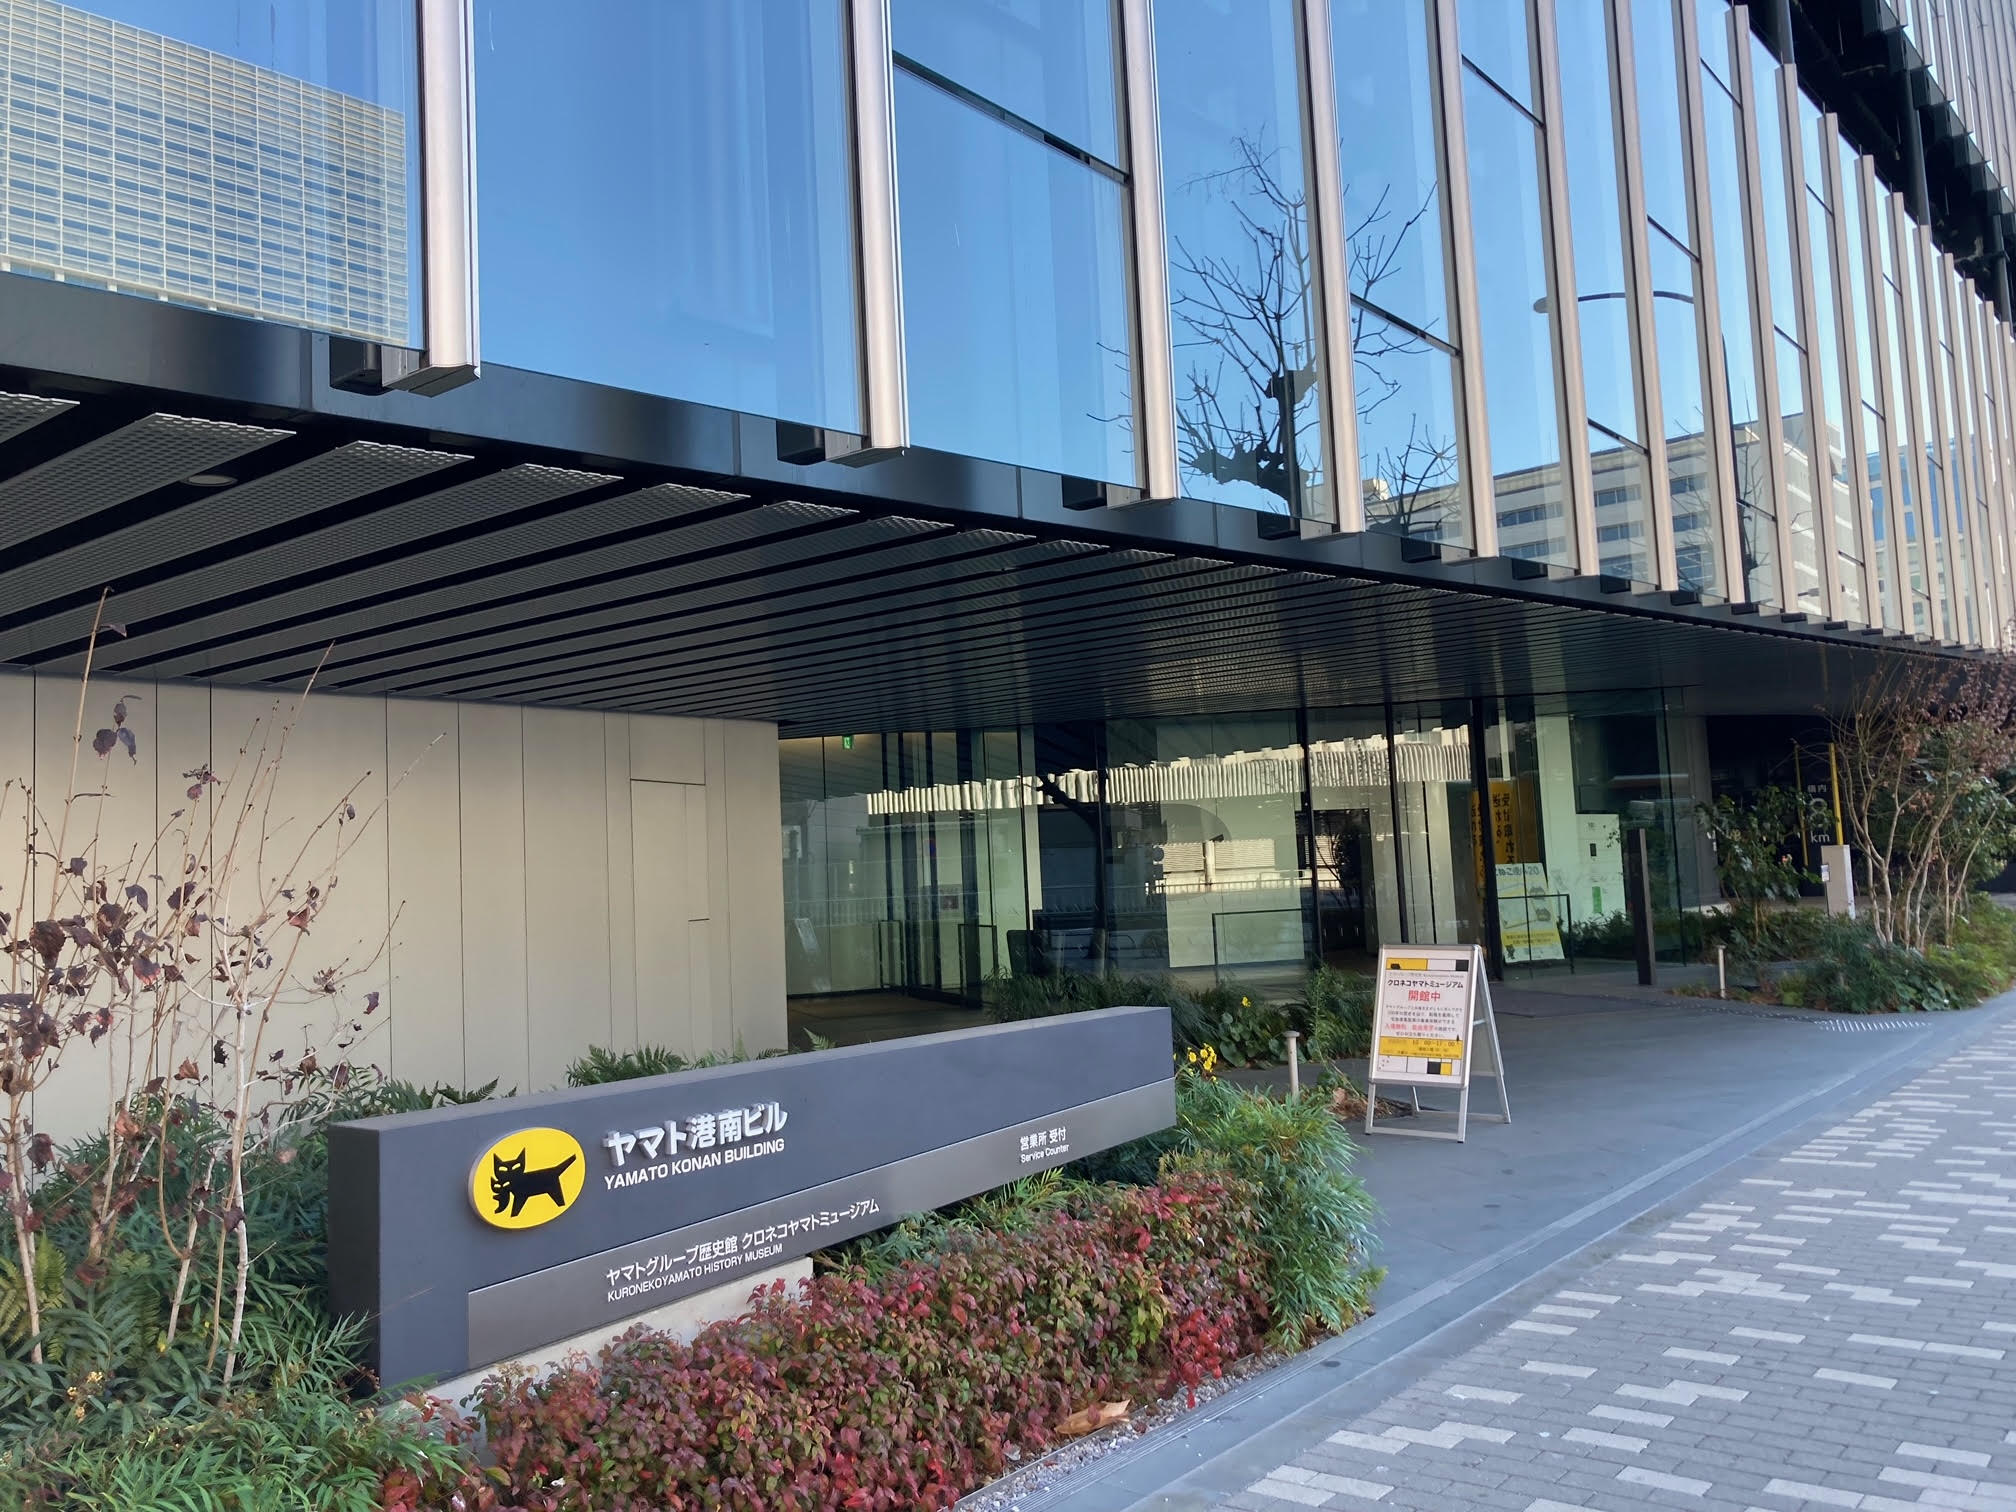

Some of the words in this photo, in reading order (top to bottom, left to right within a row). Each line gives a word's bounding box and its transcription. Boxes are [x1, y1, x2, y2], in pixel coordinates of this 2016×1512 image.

[1810, 830, 1830, 844] km
[1387, 979, 1463, 989] クロネコヤマトミュージアム
[1408, 990, 1440, 1002] 開館中
[604, 1102, 788, 1166] ヤマト港南ビル
[1020, 1131, 1047, 1151] 営業所
[1049, 1126, 1066, 1143] 受付
[604, 1162, 668, 1190] YAMATO
[671, 1150, 722, 1176] KONAN
[725, 1138, 785, 1164] BUILDING
[1020, 1151, 1044, 1163] Service
[1045, 1144, 1069, 1156] Counter
[606, 1236, 738, 1286] ヤマトグループ歴史館
[742, 1198, 880, 1250] クロネコヤマトミュージアム
[608, 1265, 703, 1303] KURONEKOYAMATO
[704, 1256, 743, 1276] HISTORY
[744, 1243, 782, 1262] MUSEUM
